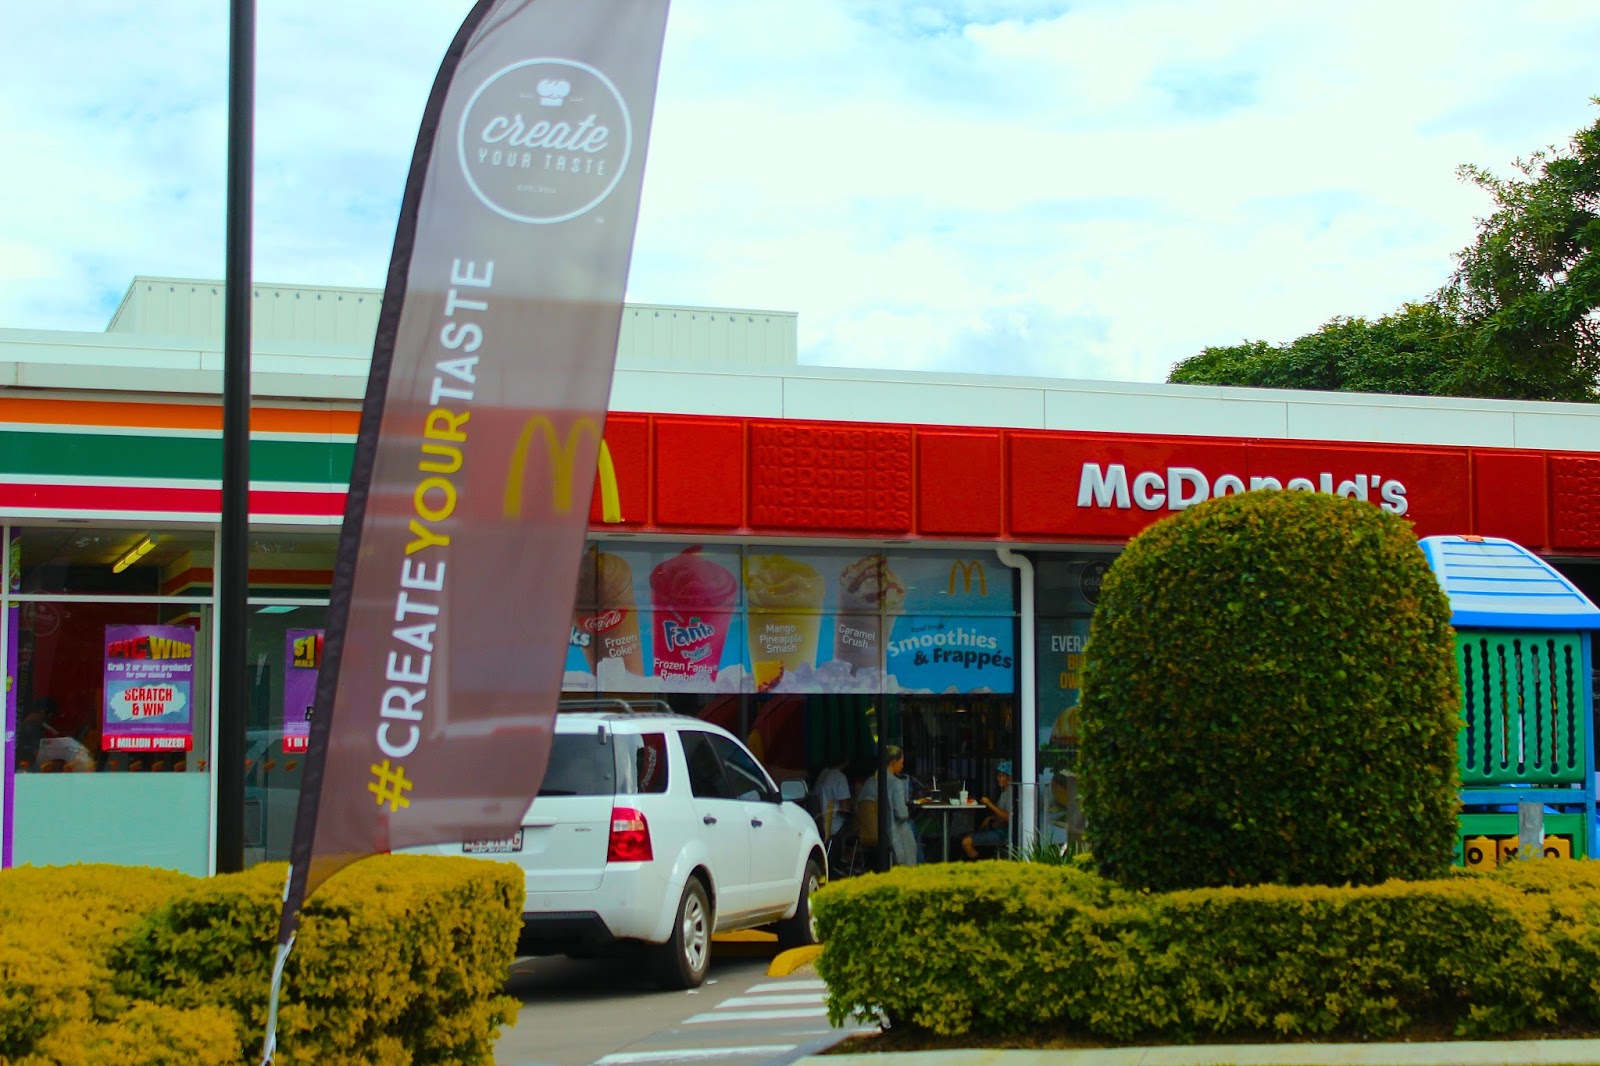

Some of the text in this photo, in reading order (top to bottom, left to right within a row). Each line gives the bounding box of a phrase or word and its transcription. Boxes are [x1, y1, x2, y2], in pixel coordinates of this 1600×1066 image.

[481, 113, 609, 153] create
[478, 148, 606, 176] YOUR TASTE
[766, 624, 796, 634] Mango
[838, 624, 876, 641] Caramel
[605, 634, 637, 648] Frozen
[663, 620, 715, 652] Fanta
[759, 634, 804, 645] Pineapple
[842, 636, 869, 648] Crush
[887, 627, 998, 658] Smoothies
[766, 645, 797, 654] Smash
[653, 658, 685, 670] Frozen
[913, 648, 1012, 670] & Frappés
[107, 663, 124, 672] Grab
[124, 688, 172, 701] SCRATCH
[132, 703, 164, 716] & WIN
[110, 737, 186, 748] 1 MILLION PRIZES!
[286, 737, 292, 748] 1
